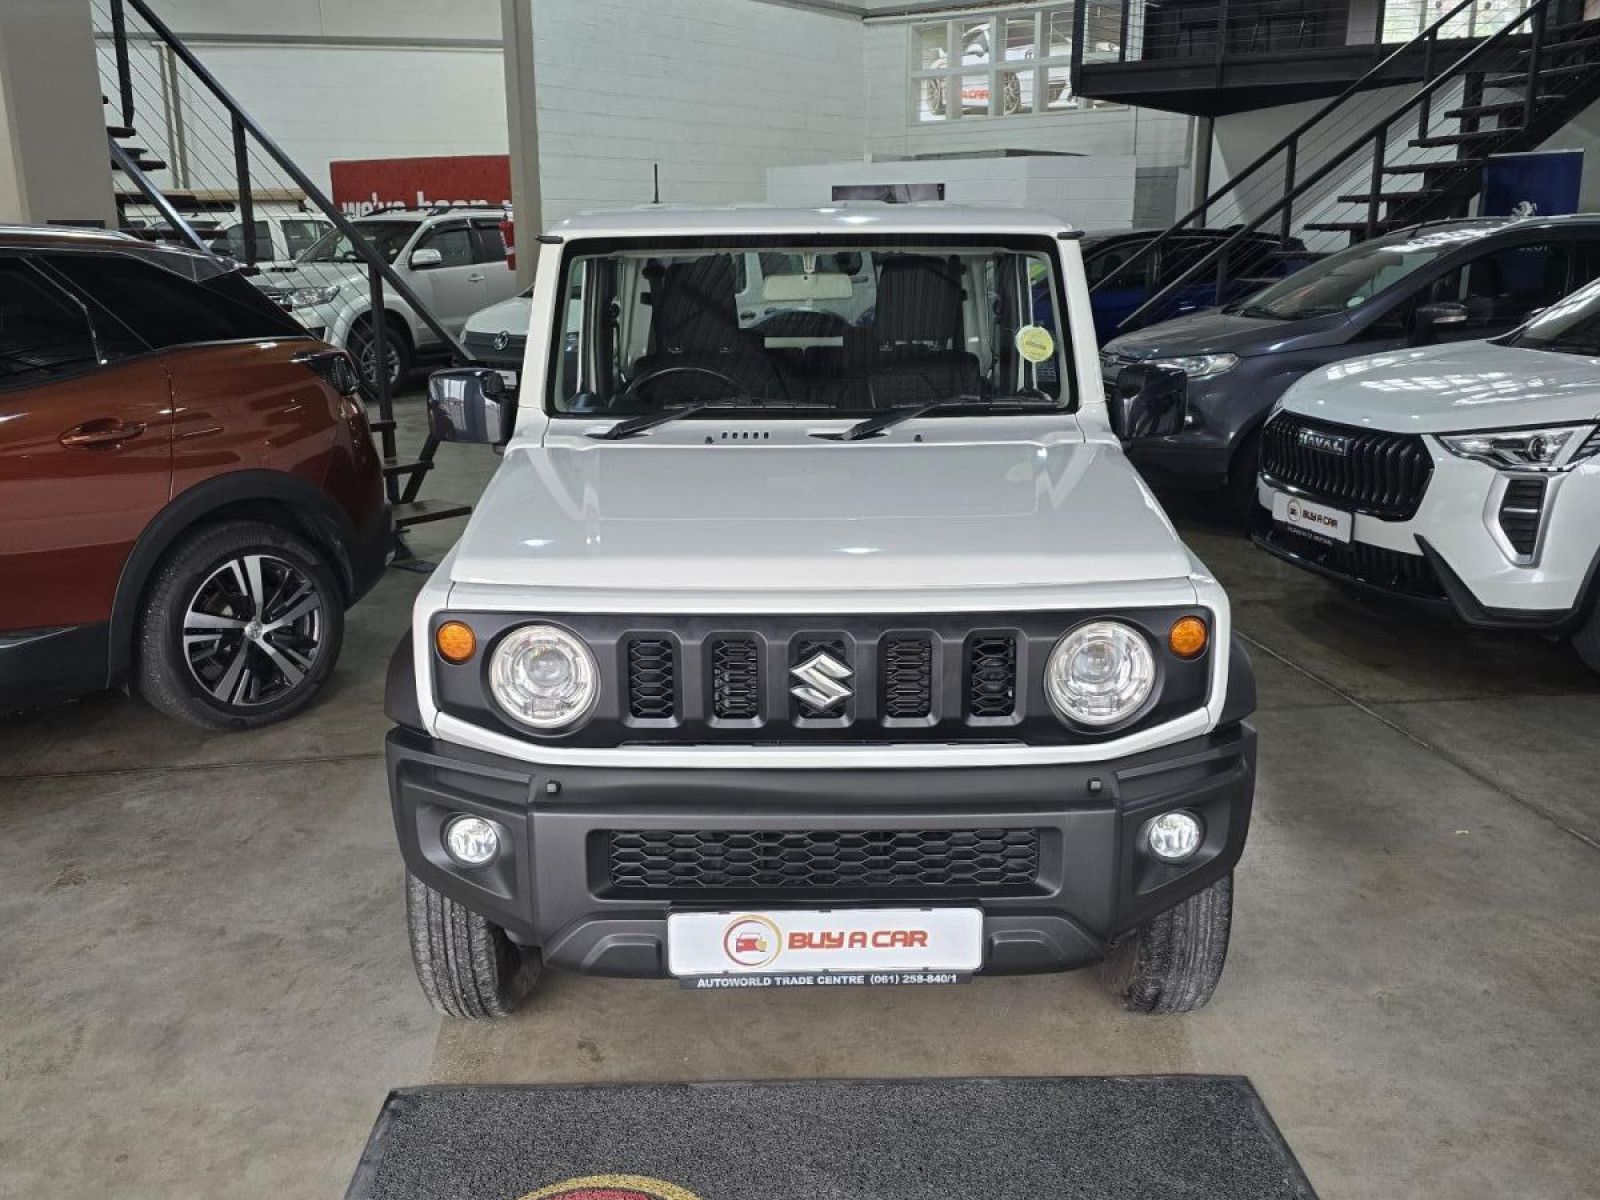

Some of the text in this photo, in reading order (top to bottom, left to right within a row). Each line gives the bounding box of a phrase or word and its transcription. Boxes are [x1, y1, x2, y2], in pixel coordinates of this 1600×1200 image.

[787, 930, 929, 950] BUY A CAR
[696, 977, 772, 989] AUTOWORLD
[774, 976, 814, 986] TRADE
[816, 975, 865, 985] CENTRE
[870, 974, 900, 985] (061)
